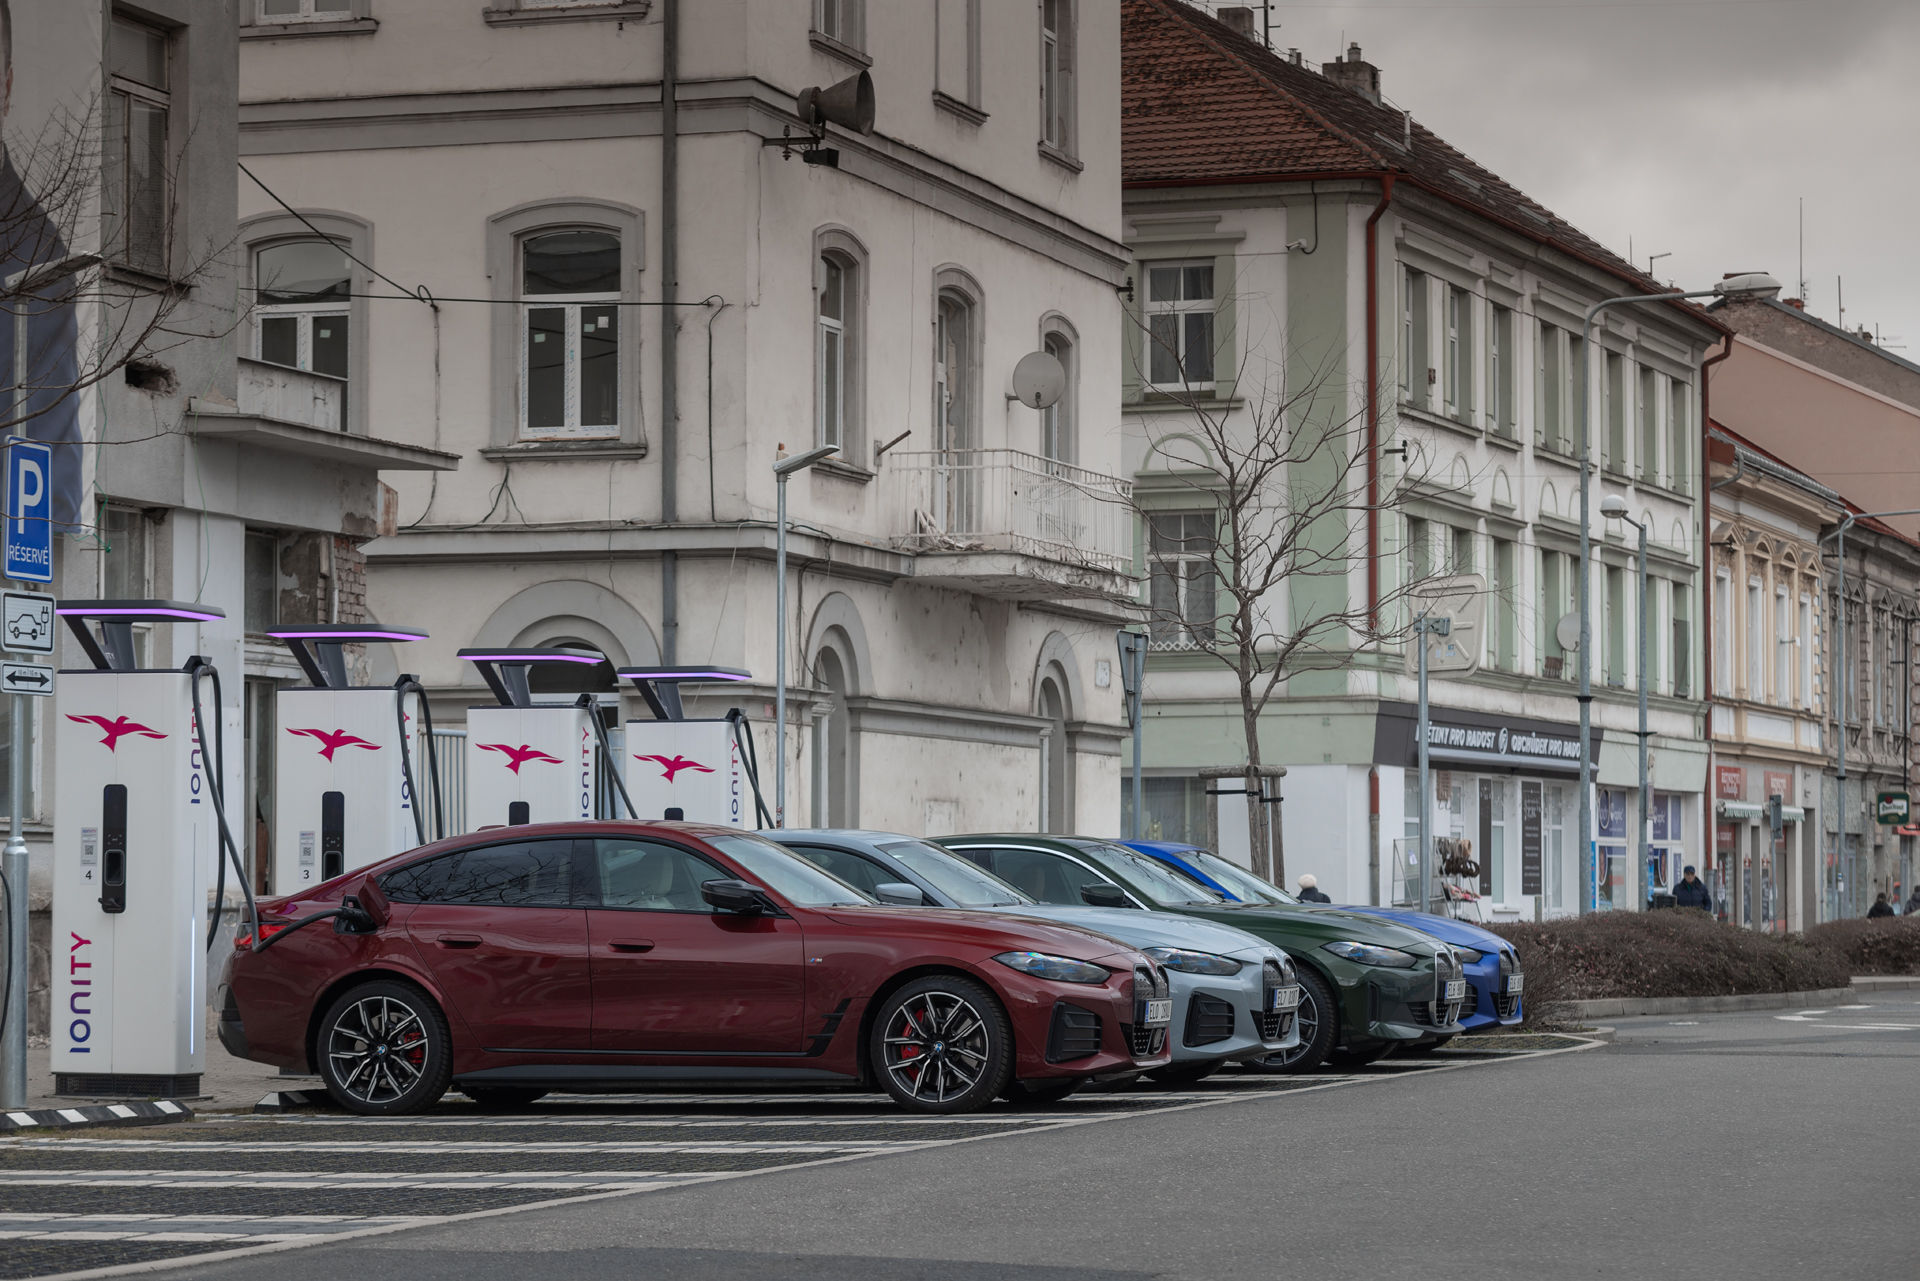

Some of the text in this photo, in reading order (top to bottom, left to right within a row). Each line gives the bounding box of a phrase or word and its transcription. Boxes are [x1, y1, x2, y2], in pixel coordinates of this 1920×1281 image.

[18, 458, 44, 534] P
[8, 542, 49, 565] RÉSERVÉ
[1449, 728, 1465, 746] PRO
[1466, 729, 1496, 749] RADOST
[1511, 732, 1580, 759] OBCHŮDEK PRO RADO
[191, 703, 202, 804] IONIT
[85, 869, 92, 880] 4
[303, 869, 310, 880] 3
[70, 931, 92, 1053] IONITY
